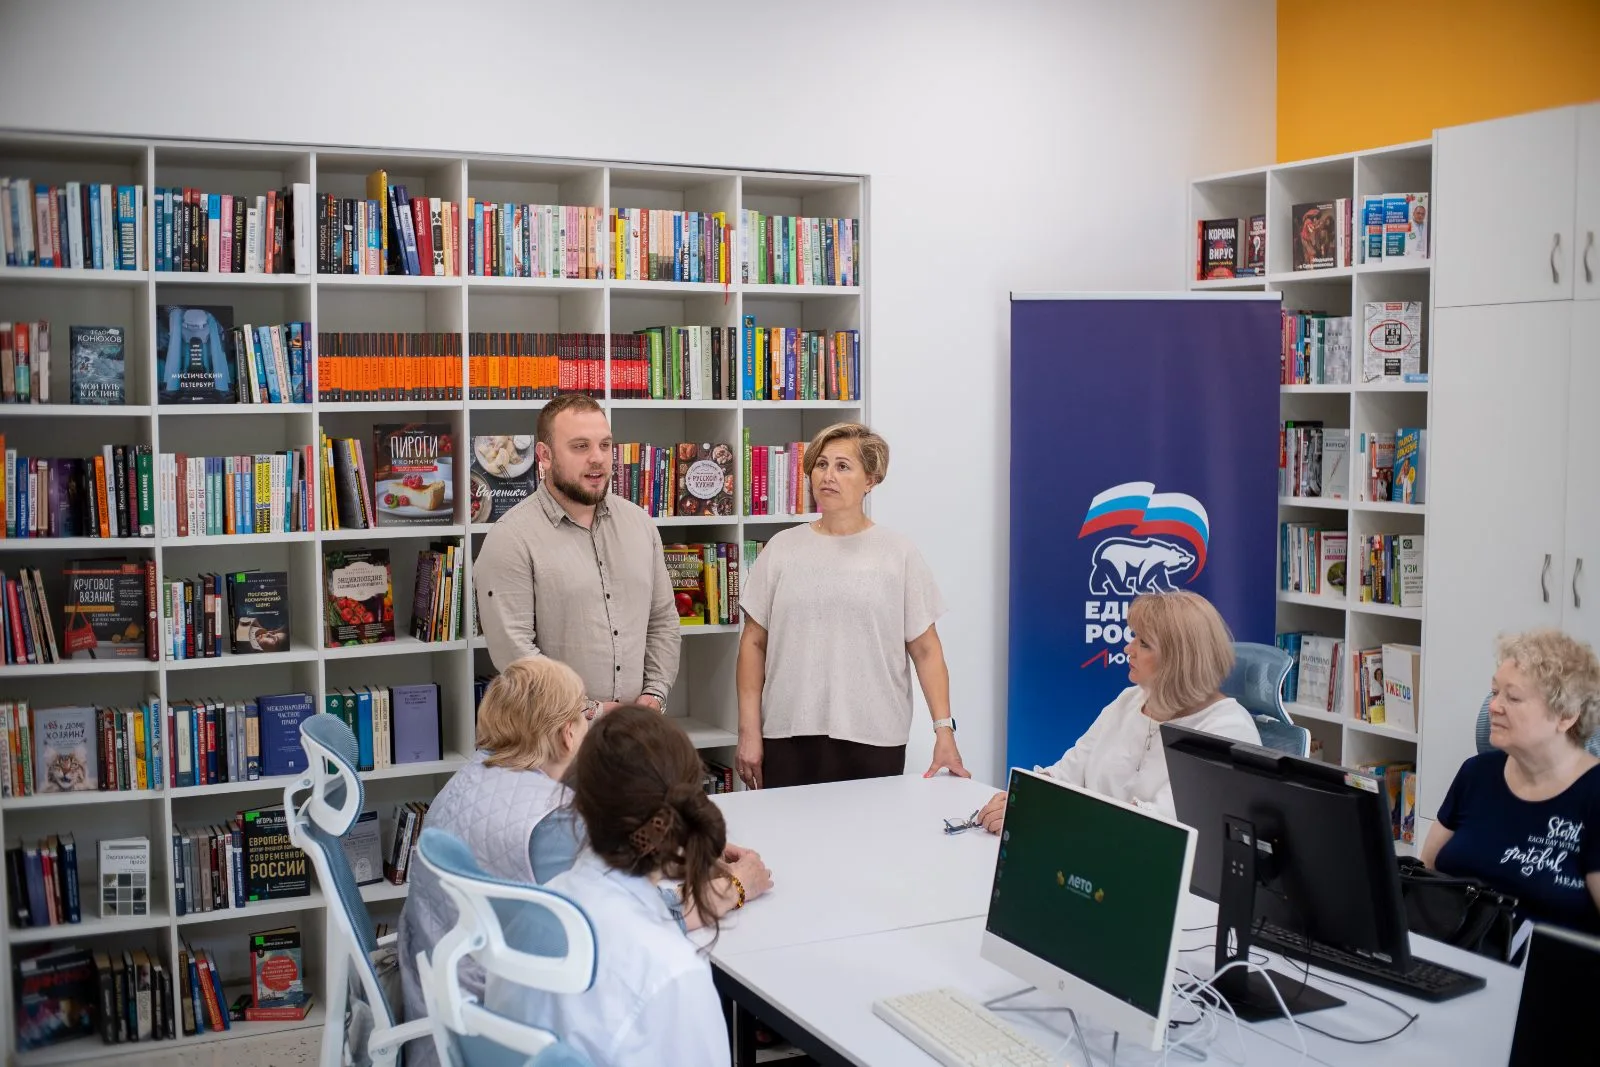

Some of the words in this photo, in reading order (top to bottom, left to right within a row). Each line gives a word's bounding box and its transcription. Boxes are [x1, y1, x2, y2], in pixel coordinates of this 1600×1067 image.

[1208, 228, 1235, 240] КОРОНА
[1209, 248, 1234, 260] ВИРУС
[77, 334, 122, 343] КОНЮХОВ
[391, 436, 438, 458] ПИРОГИ
[476, 485, 528, 497] Вареники
[1404, 564, 1418, 573] УЗИ
[74, 578, 114, 590] КРУГОВОЕ
[79, 590, 115, 603] ВЯЗАНИЕ
[1548, 816, 1583, 842] Start
[249, 834, 291, 847] ЕВРОПЕЙС
[1528, 835, 1544, 844] EACH
[1559, 841, 1574, 851] WITH
[250, 851, 305, 862] СОВРЕМЕННОЙ
[1500, 846, 1568, 872] grateful
[250, 860, 305, 879] РОССИИ
[1555, 874, 1585, 888] HEAR
